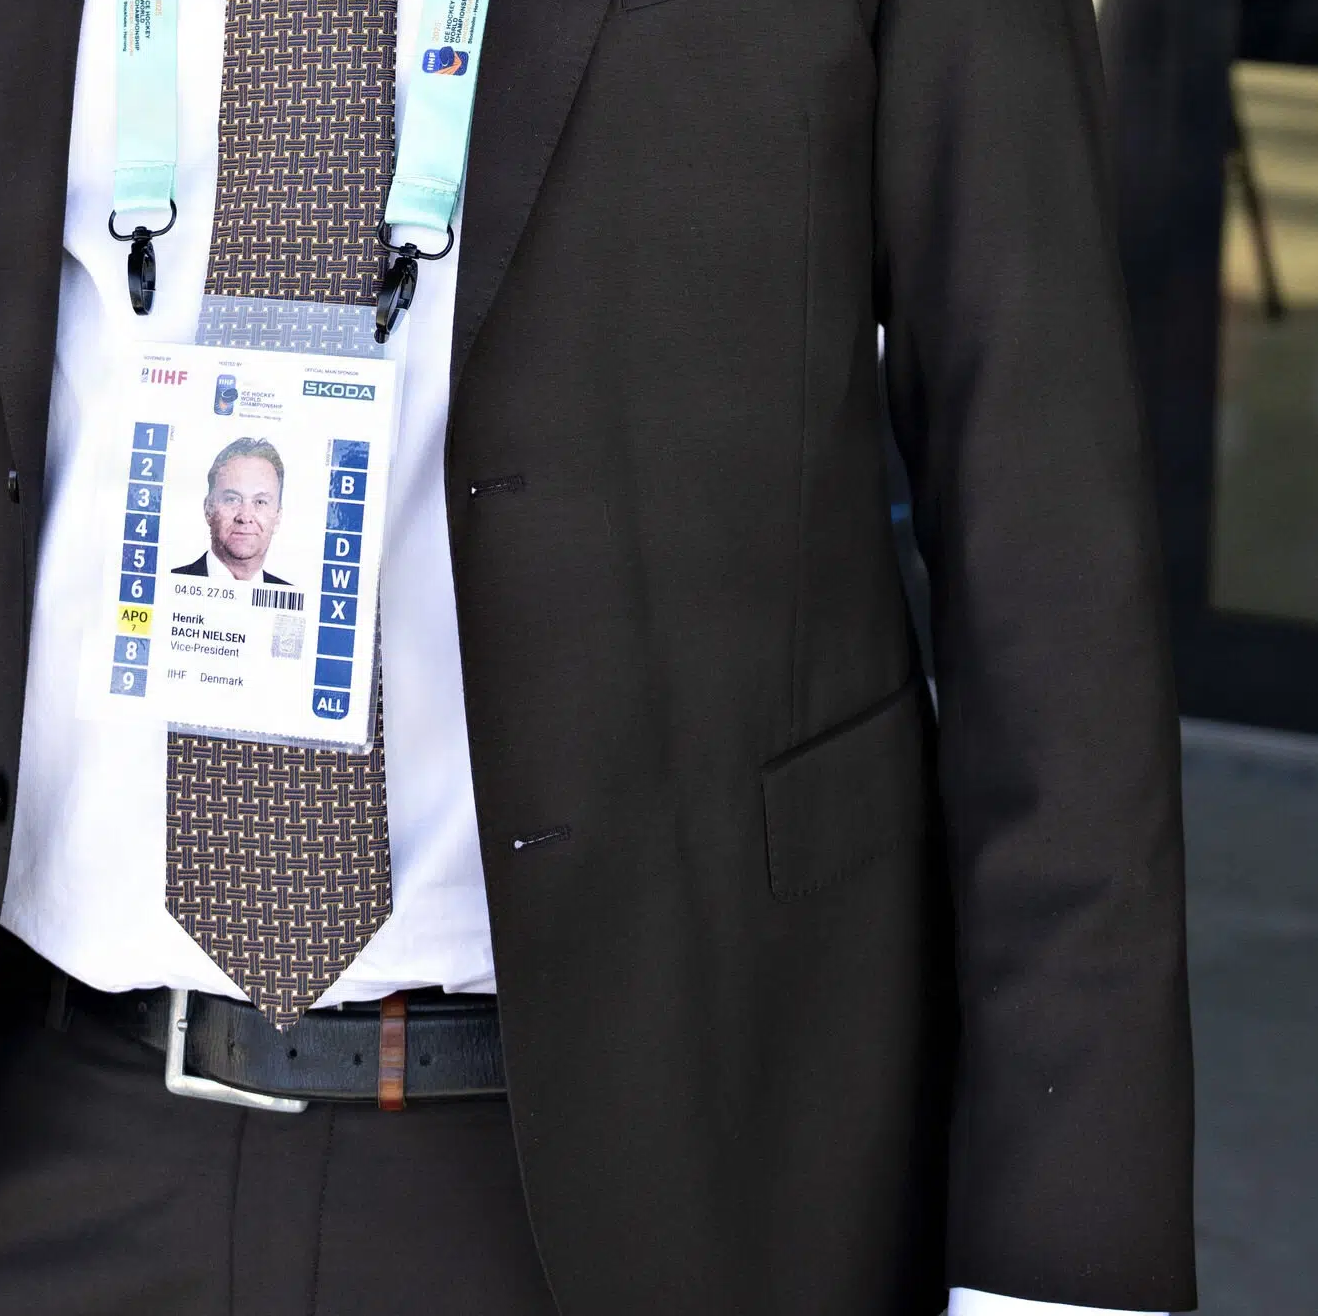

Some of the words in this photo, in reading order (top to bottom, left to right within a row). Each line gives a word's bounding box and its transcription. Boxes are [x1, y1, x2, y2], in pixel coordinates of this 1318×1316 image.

[446, 0, 455, 30] HOCKEY
[449, 17, 458, 43] WORLD
[468, 16, 476, 44] Stockholm
[426, 52, 436, 71] IIHF
[151, 369, 188, 385] IIHF
[239, 401, 284, 409] CHAMPIONSHIP
[146, 428, 154, 446] 1
[141, 458, 153, 476] 2
[341, 476, 355, 495] B
[138, 489, 150, 507] 3
[135, 519, 148, 537] 4
[336, 538, 350, 557] D
[133, 549, 145, 568] 5
[331, 569, 351, 589] W
[131, 580, 143, 598] 6
[175, 584, 203, 597] 04.05.
[207, 587, 237, 600] 27.05.
[122, 609, 148, 622] APO
[172, 612, 204, 624] Henrik
[330, 601, 346, 619] X
[171, 626, 200, 639] BACH
[202, 630, 246, 643] NIELSEN
[125, 641, 138, 660] 8
[170, 641, 239, 657] Vice-President
[123, 671, 135, 690] 9
[167, 668, 187, 680] IIHF
[200, 672, 244, 686] Denmark
[316, 696, 345, 713] ALL
